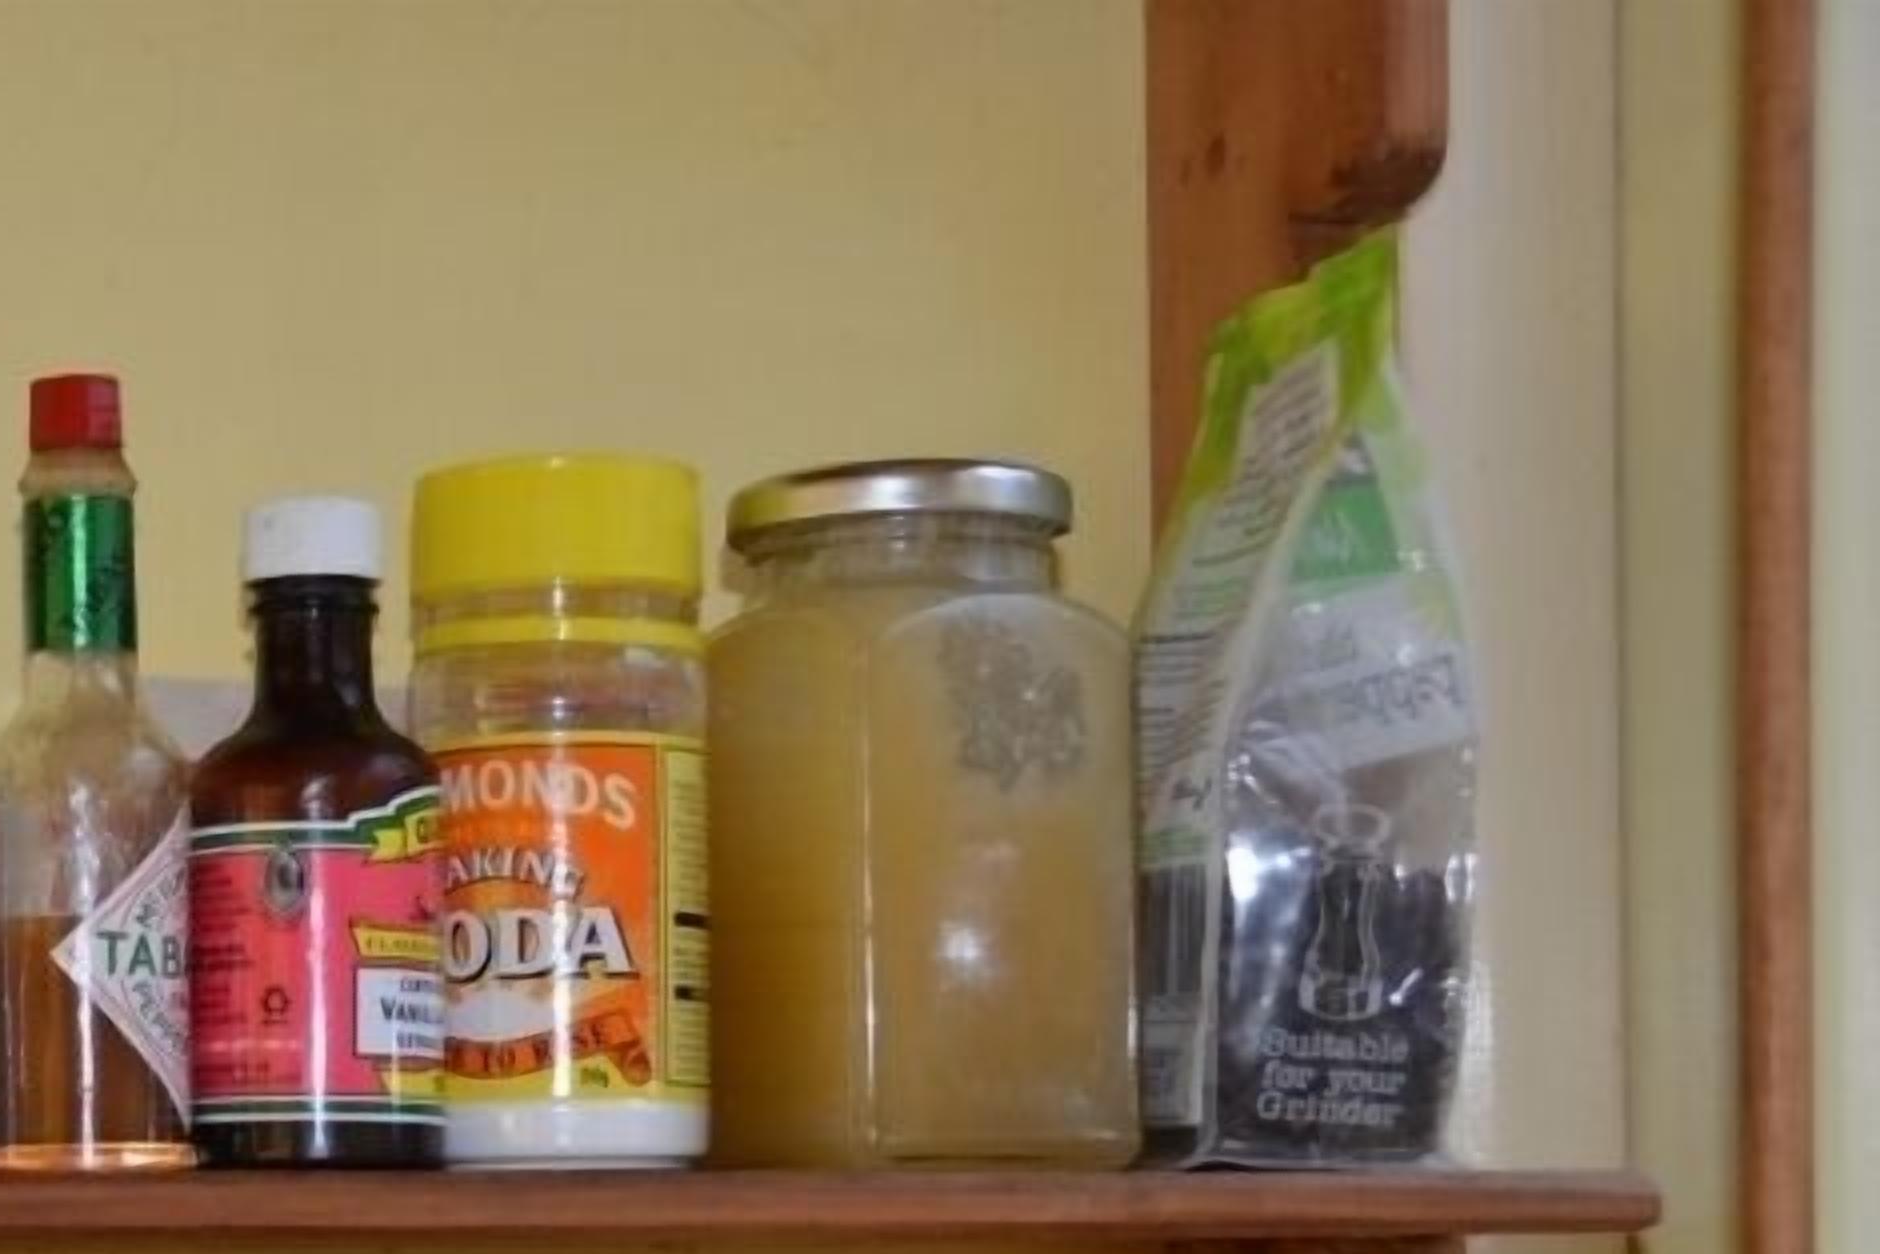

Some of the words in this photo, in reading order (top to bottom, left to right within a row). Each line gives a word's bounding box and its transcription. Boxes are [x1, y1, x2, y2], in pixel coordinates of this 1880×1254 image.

[443, 907, 638, 983] ODA
[1261, 1028, 1410, 1064] Suitable
[1262, 1060, 1315, 1090] for
[1323, 1068, 1407, 1097] your
[1256, 1090, 1405, 1127] Grinder
